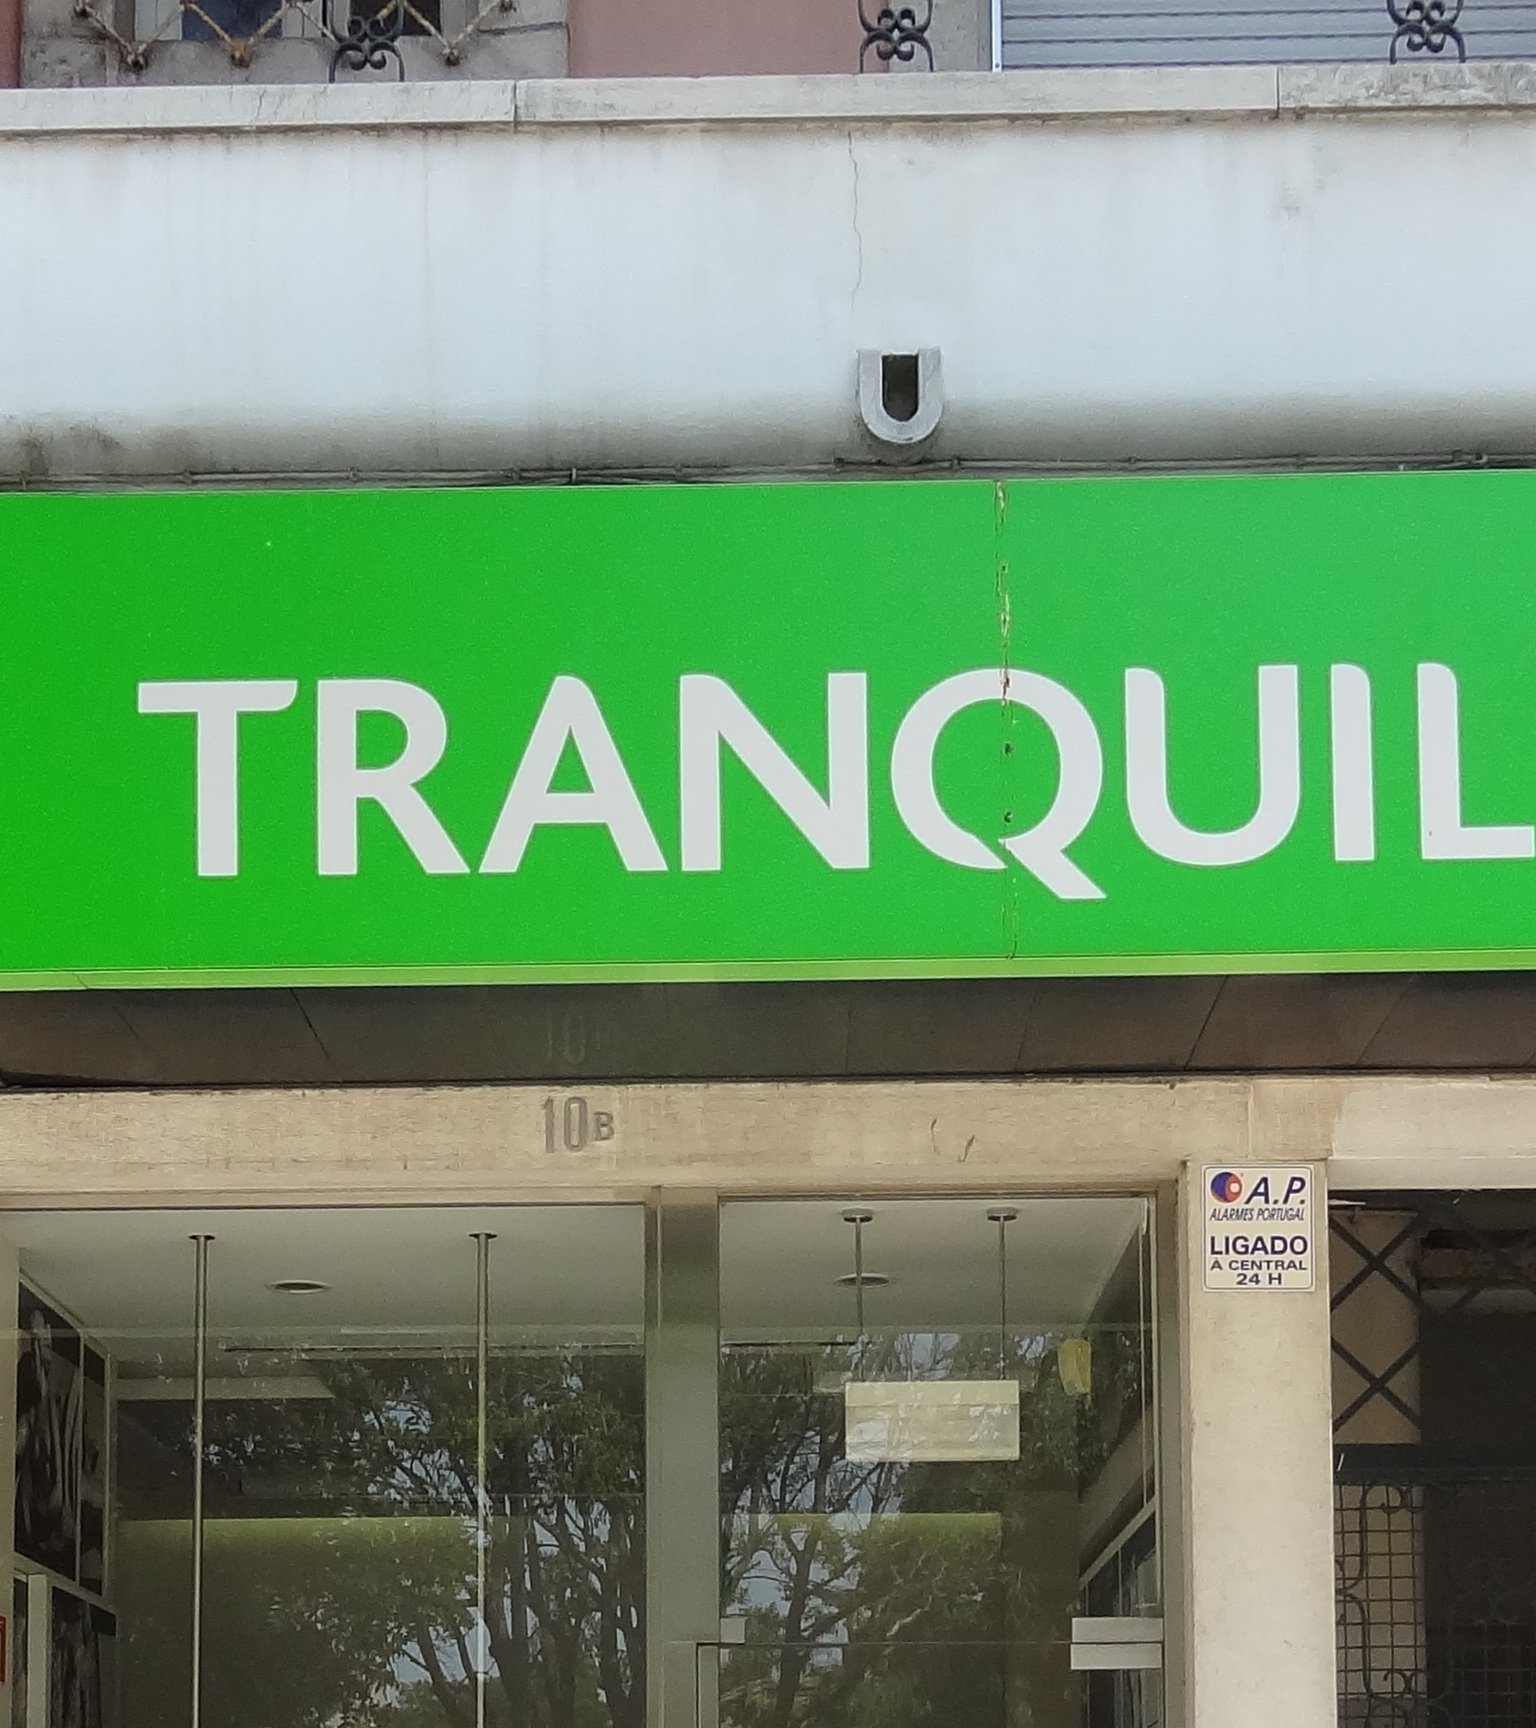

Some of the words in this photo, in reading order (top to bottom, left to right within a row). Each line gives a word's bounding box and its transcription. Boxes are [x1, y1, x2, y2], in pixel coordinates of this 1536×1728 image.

[1244, 1176, 1306, 1204] A.P.
[1210, 1208, 1254, 1221] ALARMES
[1256, 1208, 1305, 1221] PORTUGAL
[1210, 1236, 1308, 1255] LIGADO
[1228, 1260, 1308, 1271] CENTRAL
[1236, 1273, 1261, 1285] 24
[1268, 1273, 1282, 1285] H
